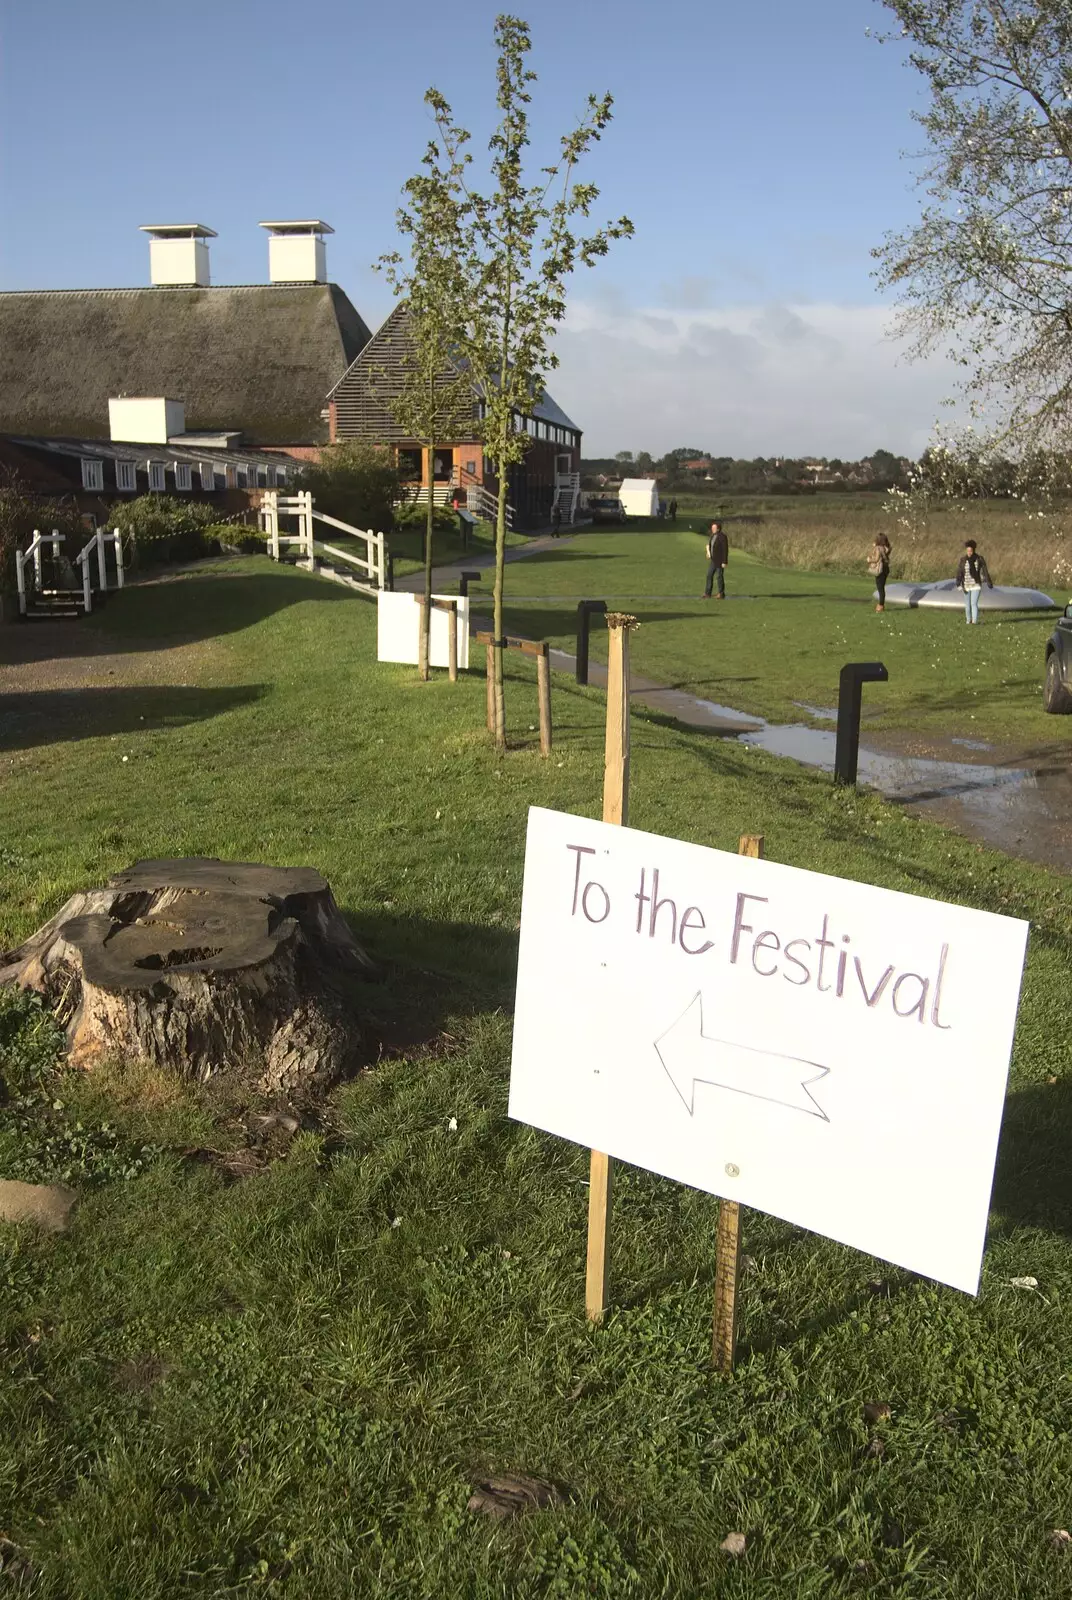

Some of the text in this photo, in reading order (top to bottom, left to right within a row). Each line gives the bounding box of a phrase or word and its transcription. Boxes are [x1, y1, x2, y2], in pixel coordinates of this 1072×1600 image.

[567, 844, 951, 1029] To the Festival
